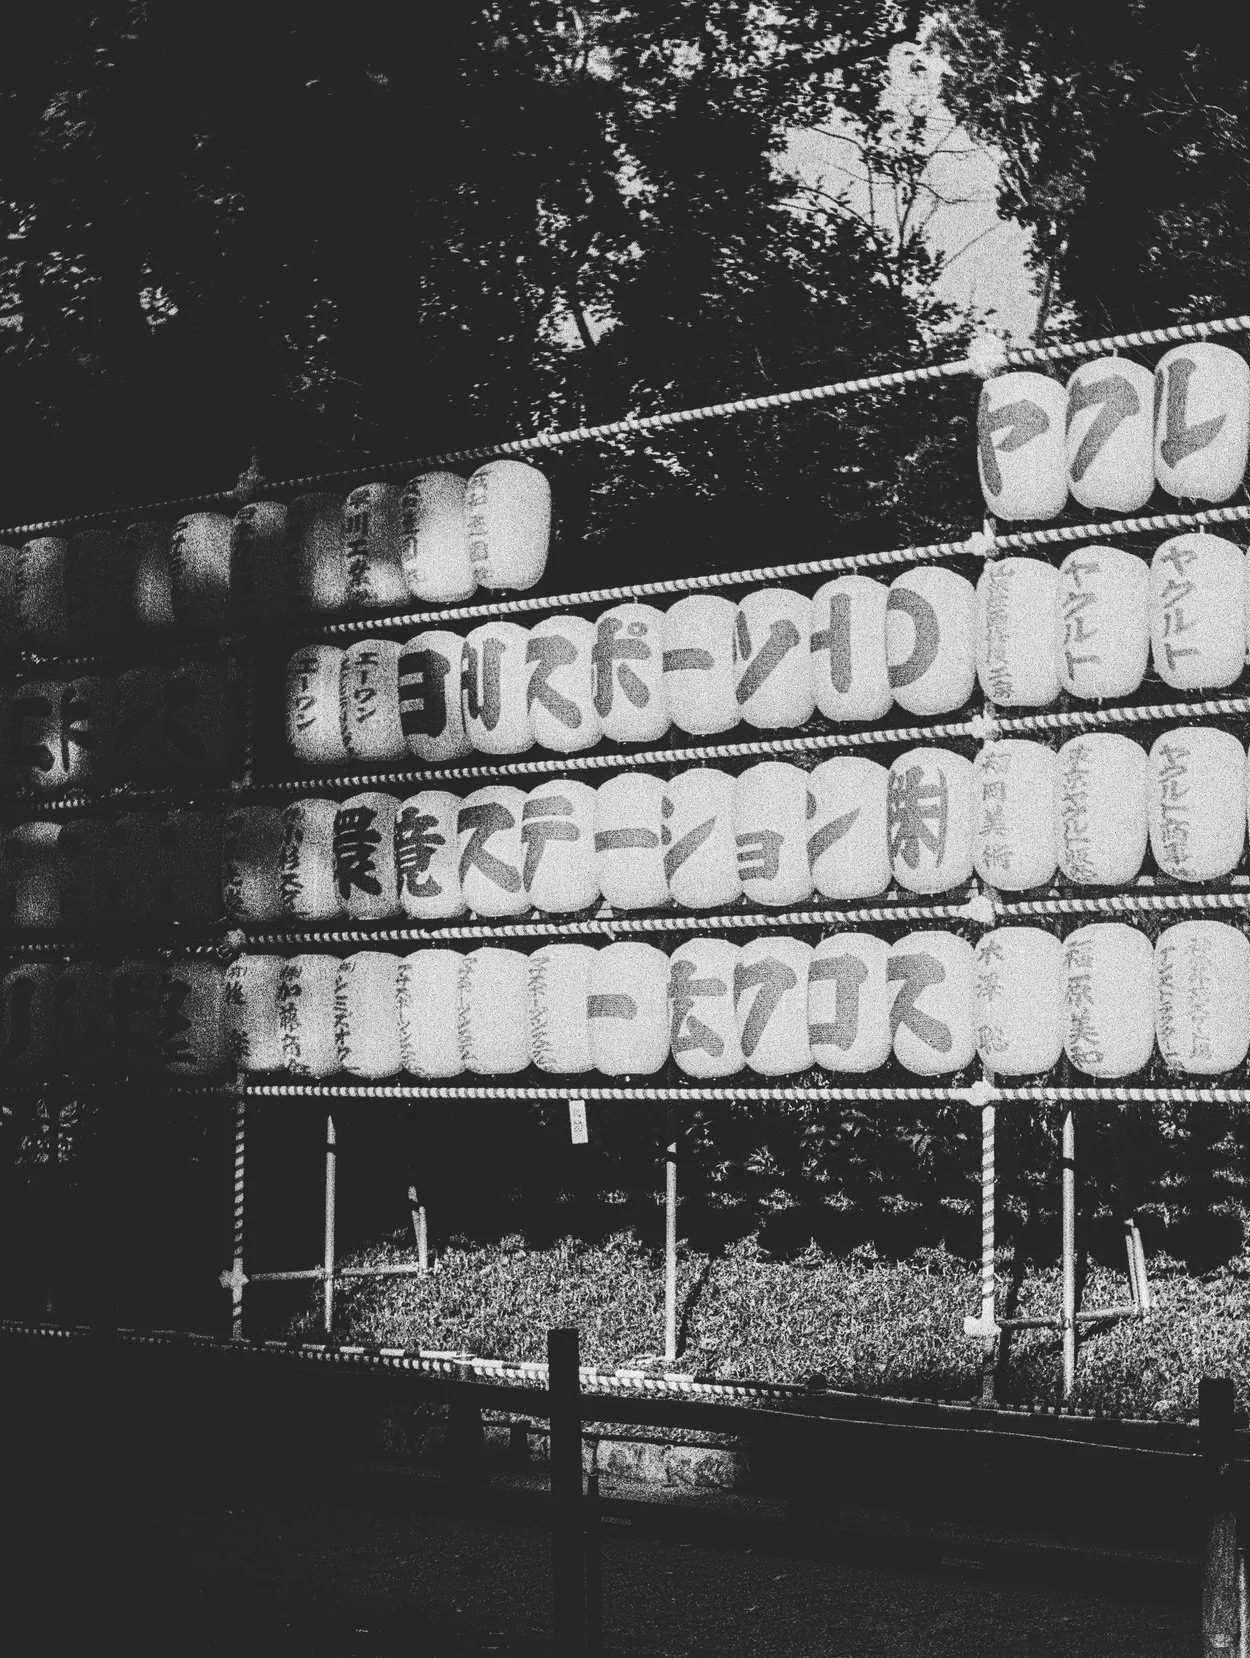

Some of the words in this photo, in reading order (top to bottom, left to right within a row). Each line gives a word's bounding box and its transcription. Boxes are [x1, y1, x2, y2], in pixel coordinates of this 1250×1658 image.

[1062, 561, 1101, 681] ヤクルト
[1161, 547, 1199, 670] ヤクルト
